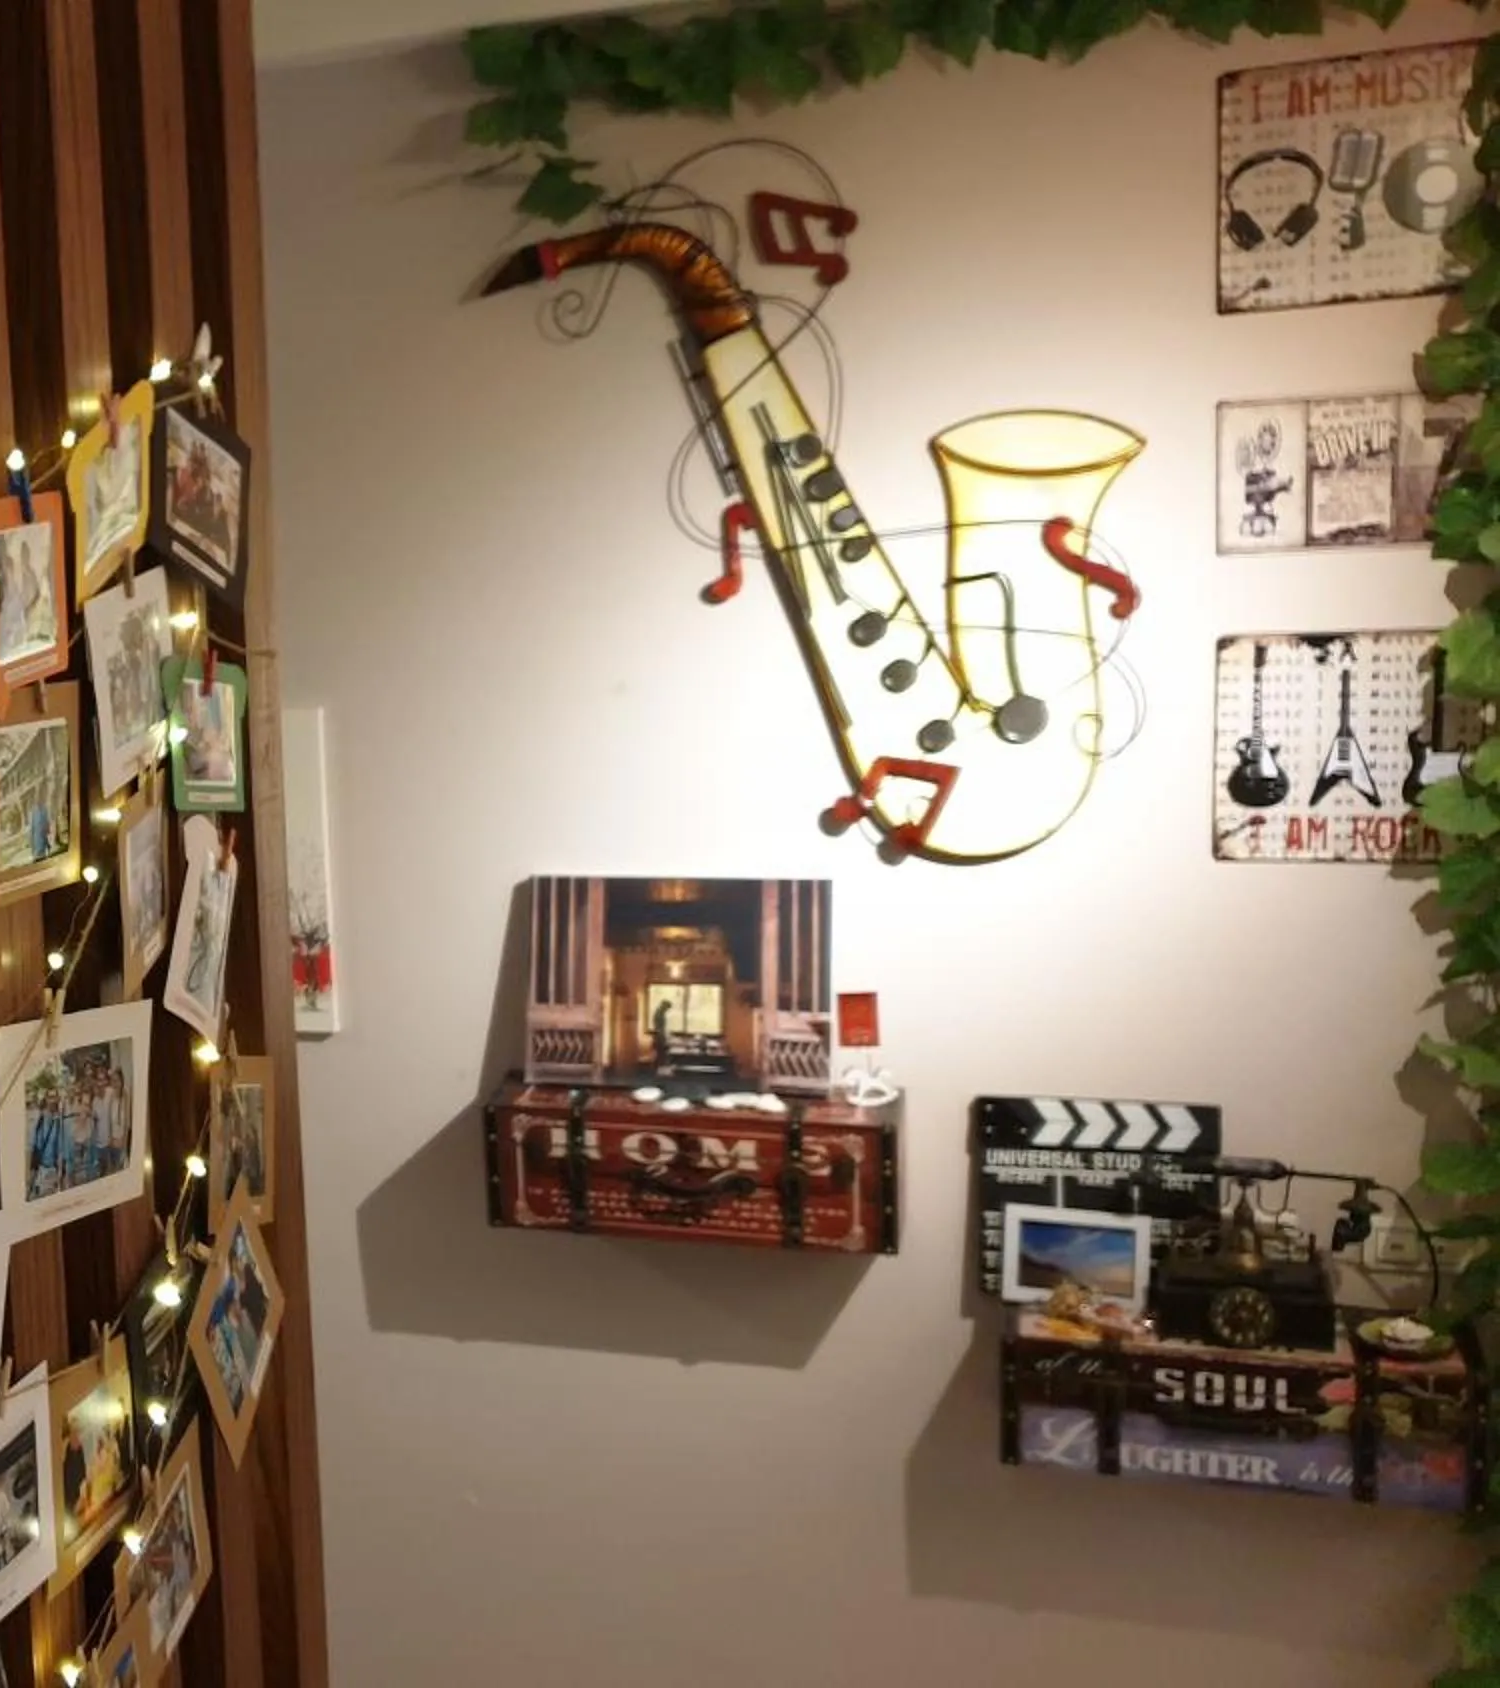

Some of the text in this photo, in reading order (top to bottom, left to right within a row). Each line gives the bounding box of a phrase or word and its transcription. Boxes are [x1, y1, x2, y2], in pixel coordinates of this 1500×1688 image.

[1287, 75, 1332, 118] AM
[1286, 817, 1329, 852] AM
[985, 1148, 1085, 1169] UNIVERSAL
[1153, 1367, 1308, 1414] SOUL
[1023, 1412, 1280, 1485] LUGHTER
